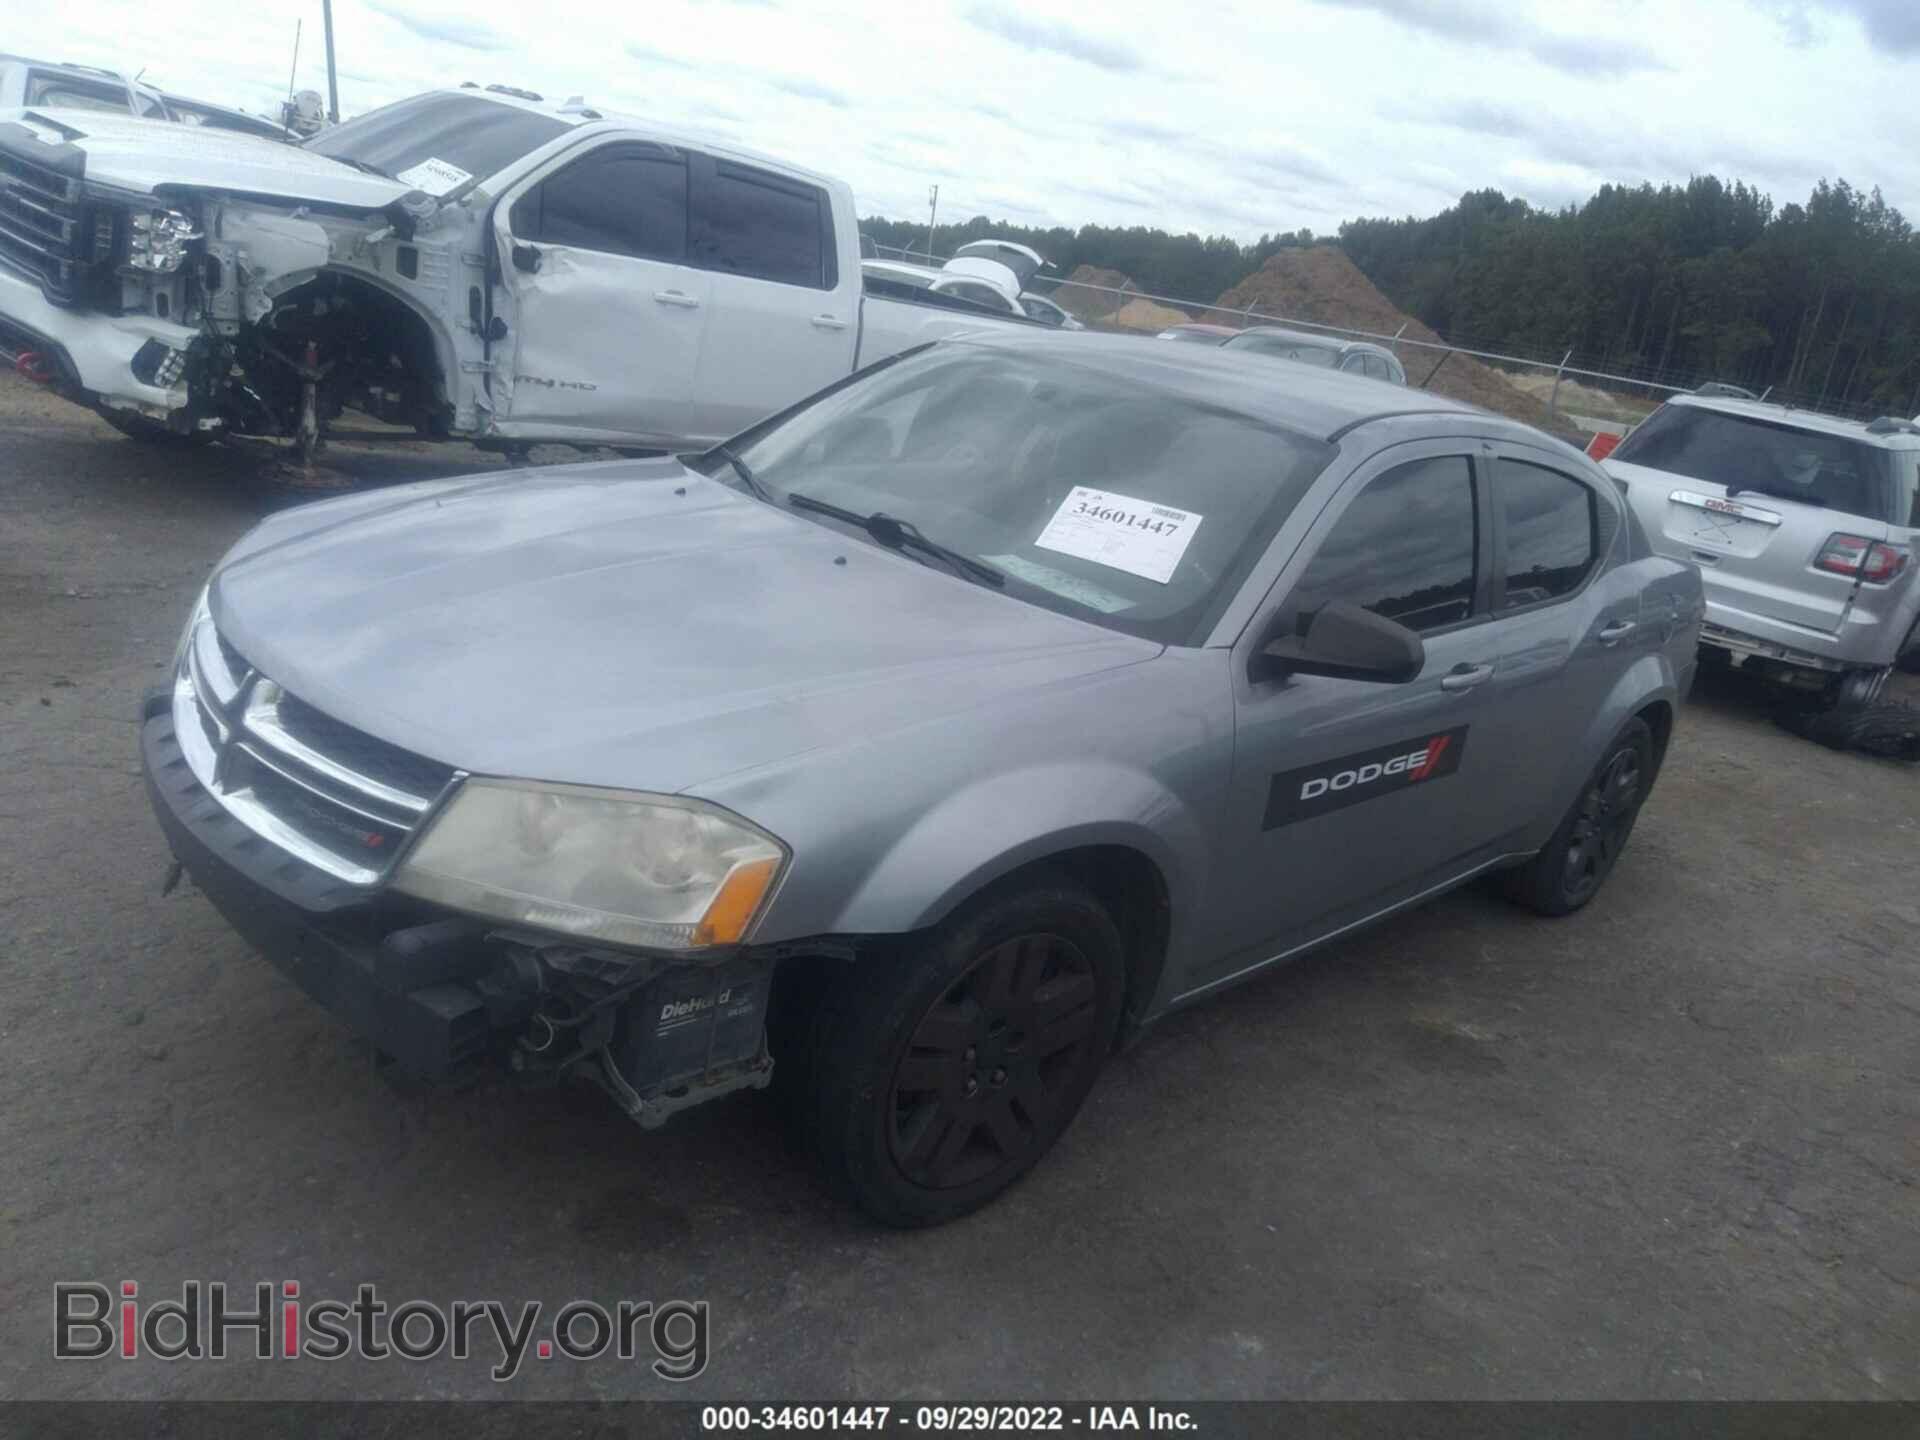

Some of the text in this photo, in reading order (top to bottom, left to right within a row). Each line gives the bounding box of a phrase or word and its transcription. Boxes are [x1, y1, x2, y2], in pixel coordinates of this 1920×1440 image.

[1072, 501, 1179, 537] 34601447
[1705, 499, 1744, 513] GMC
[1300, 749, 1430, 800] DODGE
